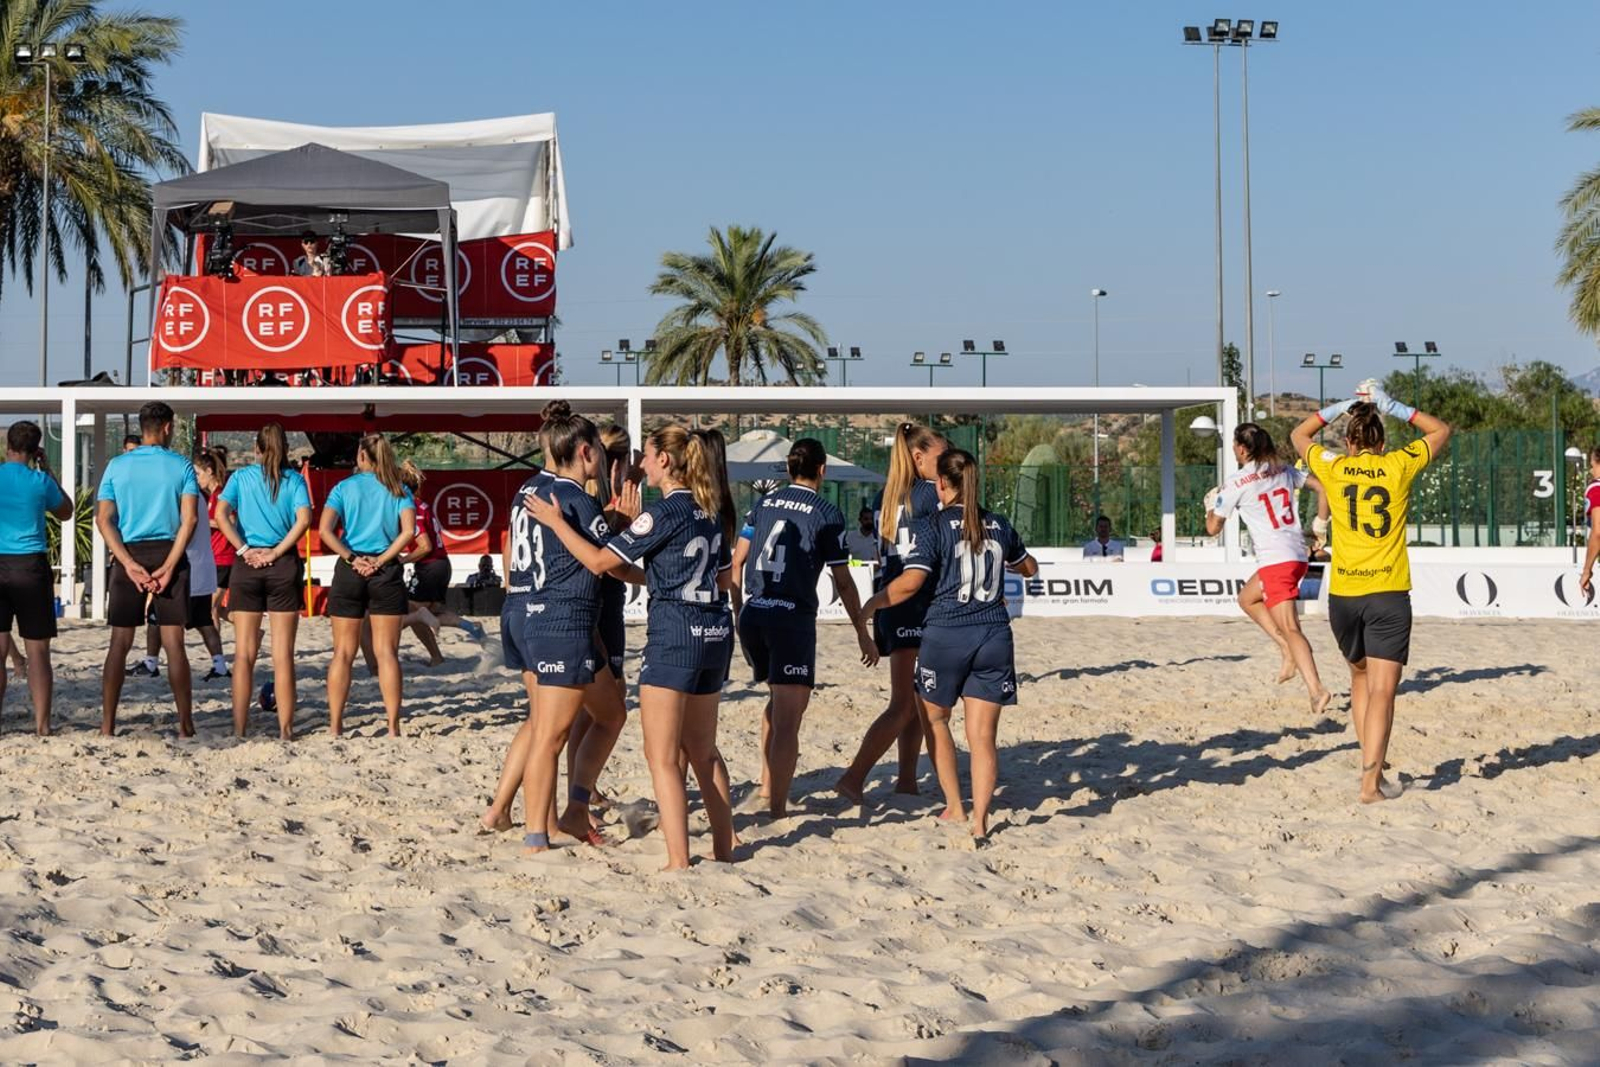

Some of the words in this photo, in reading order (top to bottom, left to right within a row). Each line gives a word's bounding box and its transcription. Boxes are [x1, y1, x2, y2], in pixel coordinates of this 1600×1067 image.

[515, 257, 547, 270] RF
[515, 274, 547, 287] EF
[165, 303, 193, 317] RF
[258, 303, 294, 317] RF
[165, 321, 193, 335] EF
[258, 321, 294, 335] EF
[1344, 466, 1386, 479] MARIA
[1533, 470, 1554, 498] 3
[447, 497, 479, 508] RF
[762, 498, 814, 514] S.PRIM
[1258, 487, 1295, 529] 13
[1342, 484, 1392, 538] 13
[447, 513, 479, 525] EF
[755, 519, 786, 582] 4
[954, 539, 1003, 603] 10
